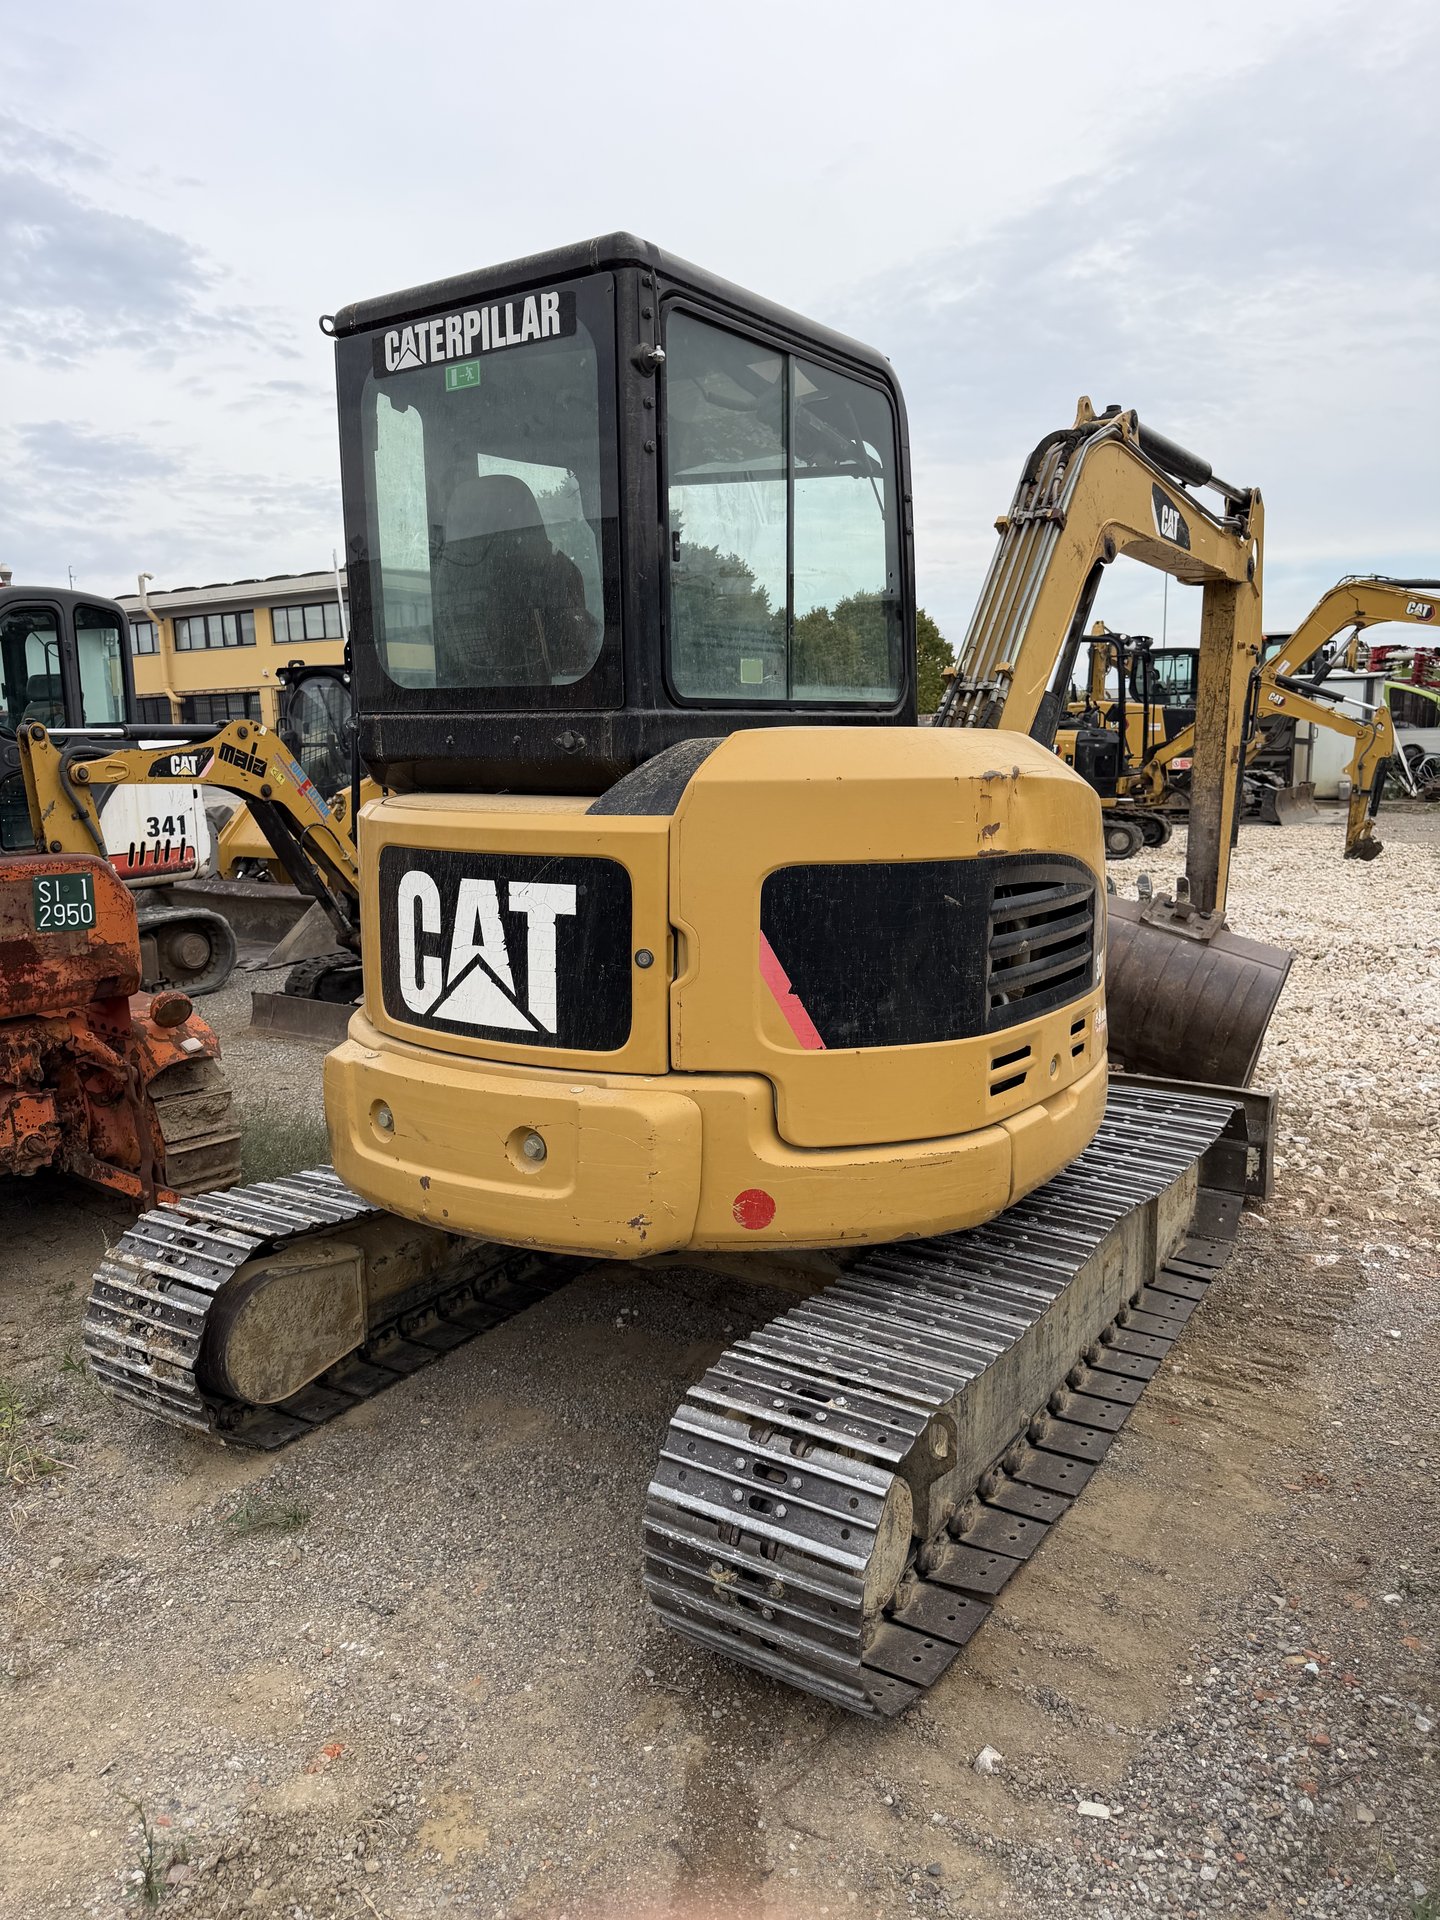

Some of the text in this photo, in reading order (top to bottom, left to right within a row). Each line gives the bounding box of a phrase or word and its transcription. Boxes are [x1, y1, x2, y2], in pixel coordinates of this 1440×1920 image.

[384, 291, 561, 372] CATERPILLAR
[1161, 504, 1180, 541] CAT
[1406, 601, 1431, 618] CAT
[1268, 692, 1284, 705] CAT
[170, 755, 198, 776] CAT
[146, 814, 186, 838] 341
[38, 878, 87, 903] SI 1
[39, 902, 93, 927] 2950
[398, 870, 577, 1034] CAT
